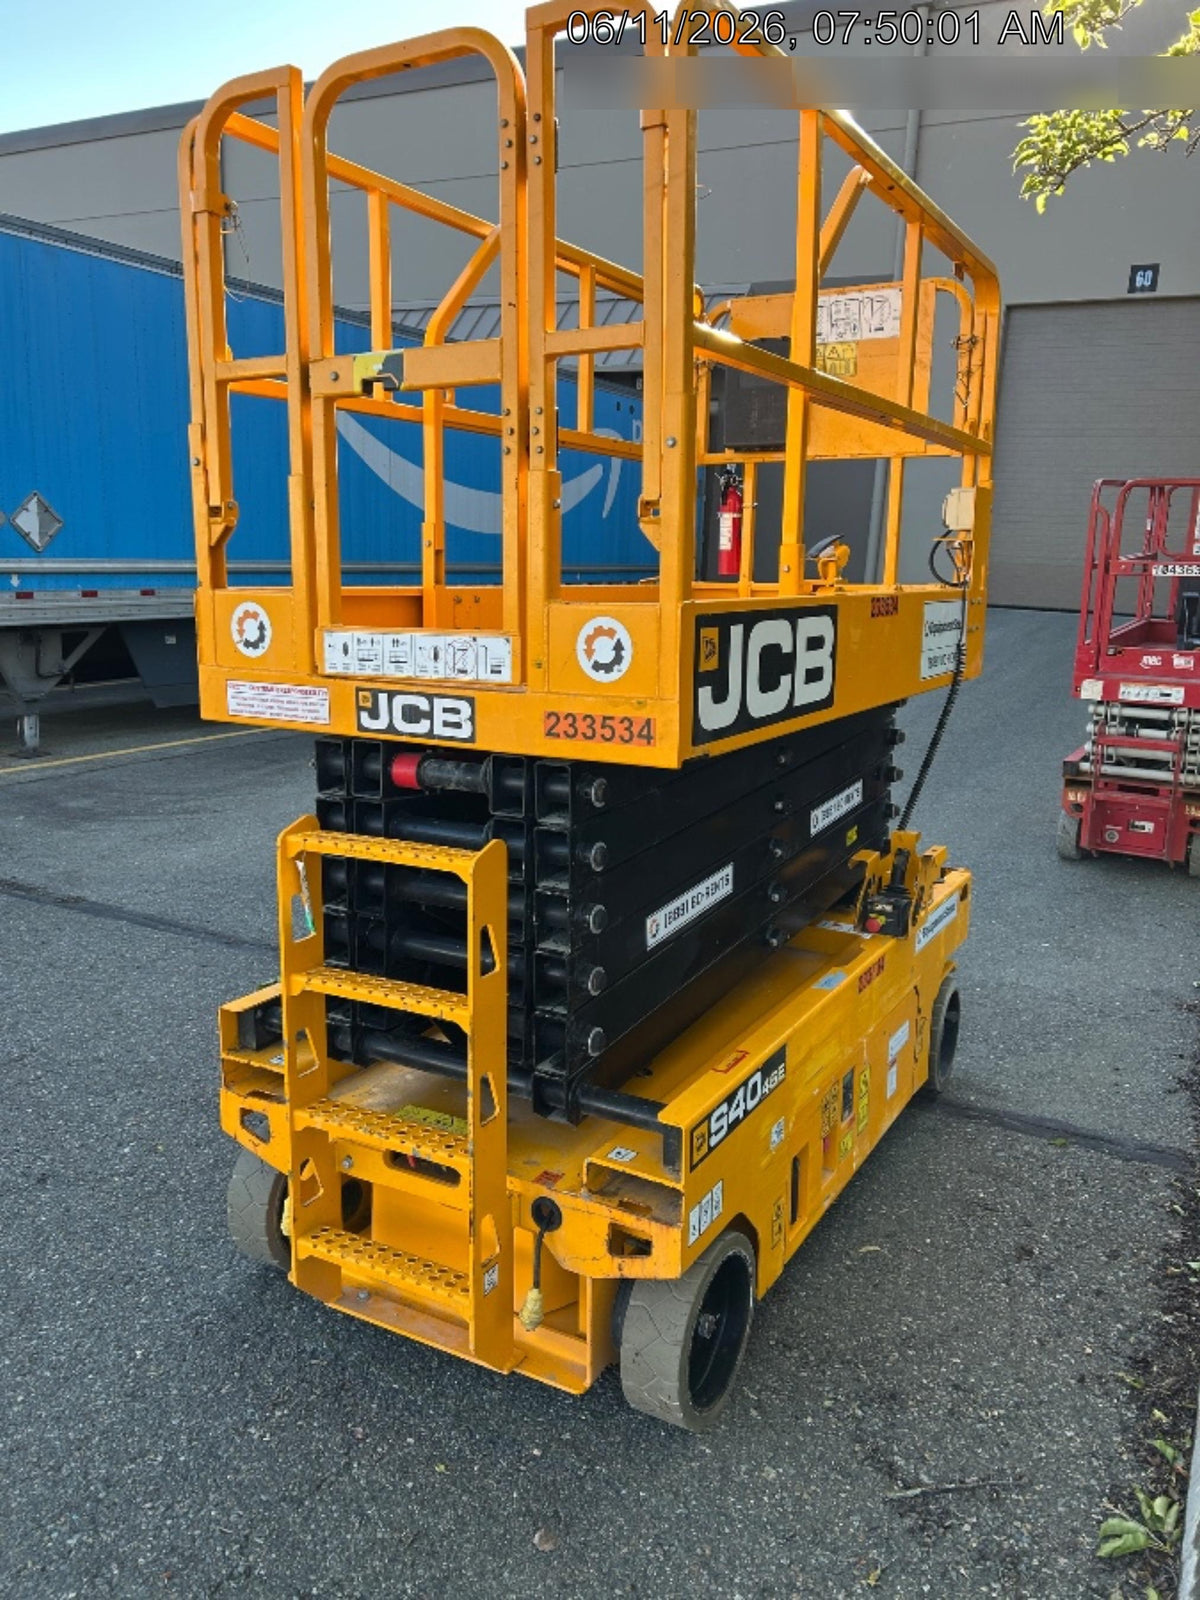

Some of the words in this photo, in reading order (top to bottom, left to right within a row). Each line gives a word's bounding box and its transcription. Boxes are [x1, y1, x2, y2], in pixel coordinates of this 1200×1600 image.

[1136, 270, 1153, 287] 60
[698, 615, 834, 731] JCB
[360, 692, 473, 739] JCB
[545, 711, 654, 746] 233534
